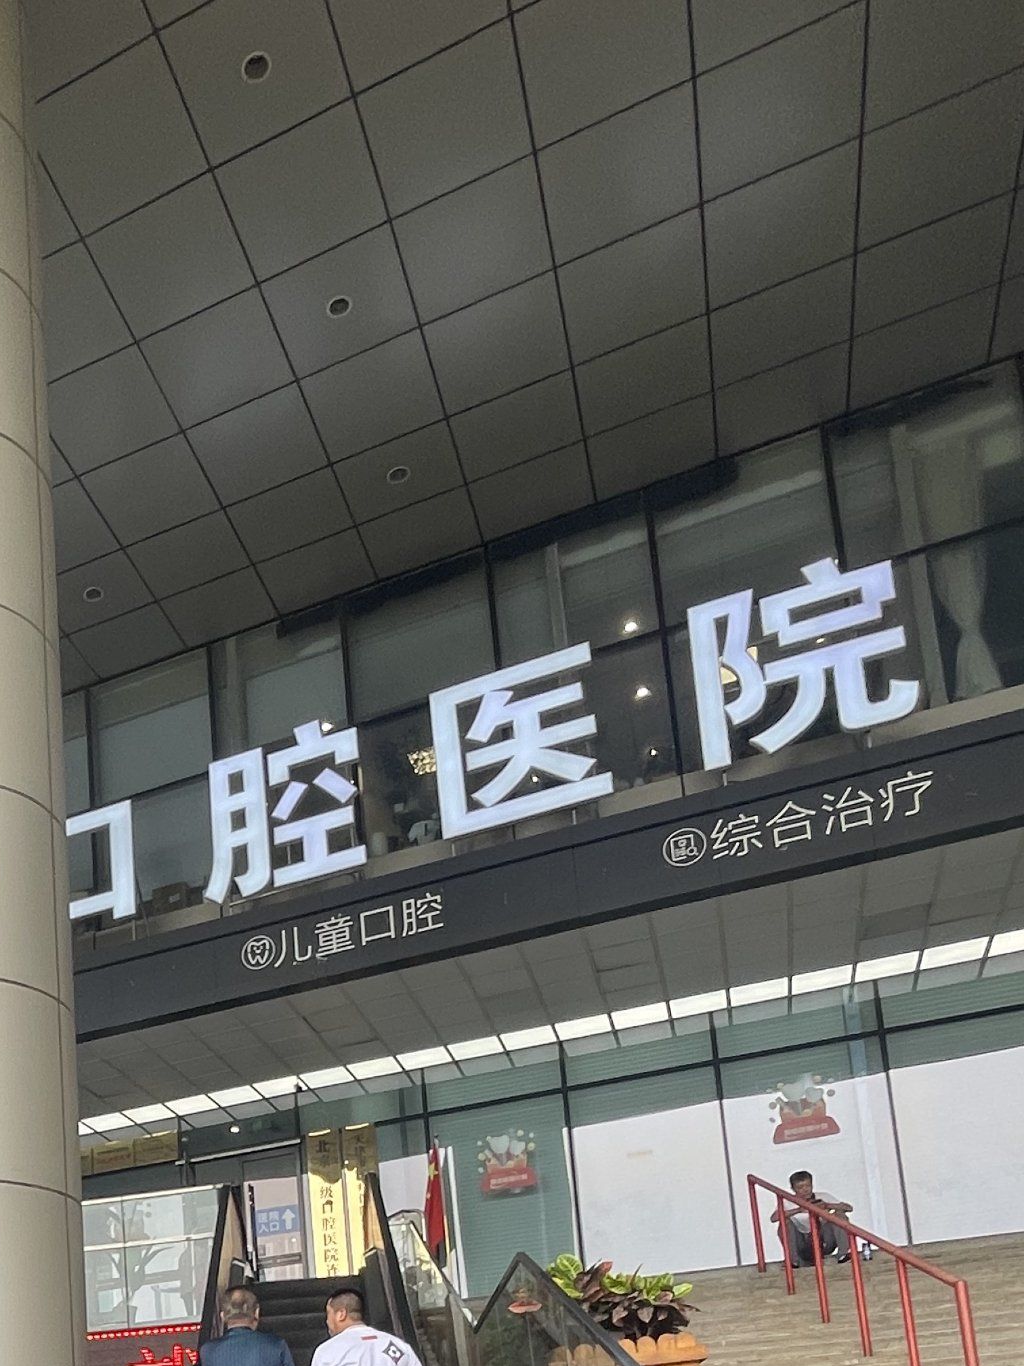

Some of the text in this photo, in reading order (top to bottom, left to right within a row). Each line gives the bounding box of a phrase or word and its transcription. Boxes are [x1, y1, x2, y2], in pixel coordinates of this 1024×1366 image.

[710, 771, 934, 860] 综合治疗
[273, 892, 445, 968] 儿童口腔
